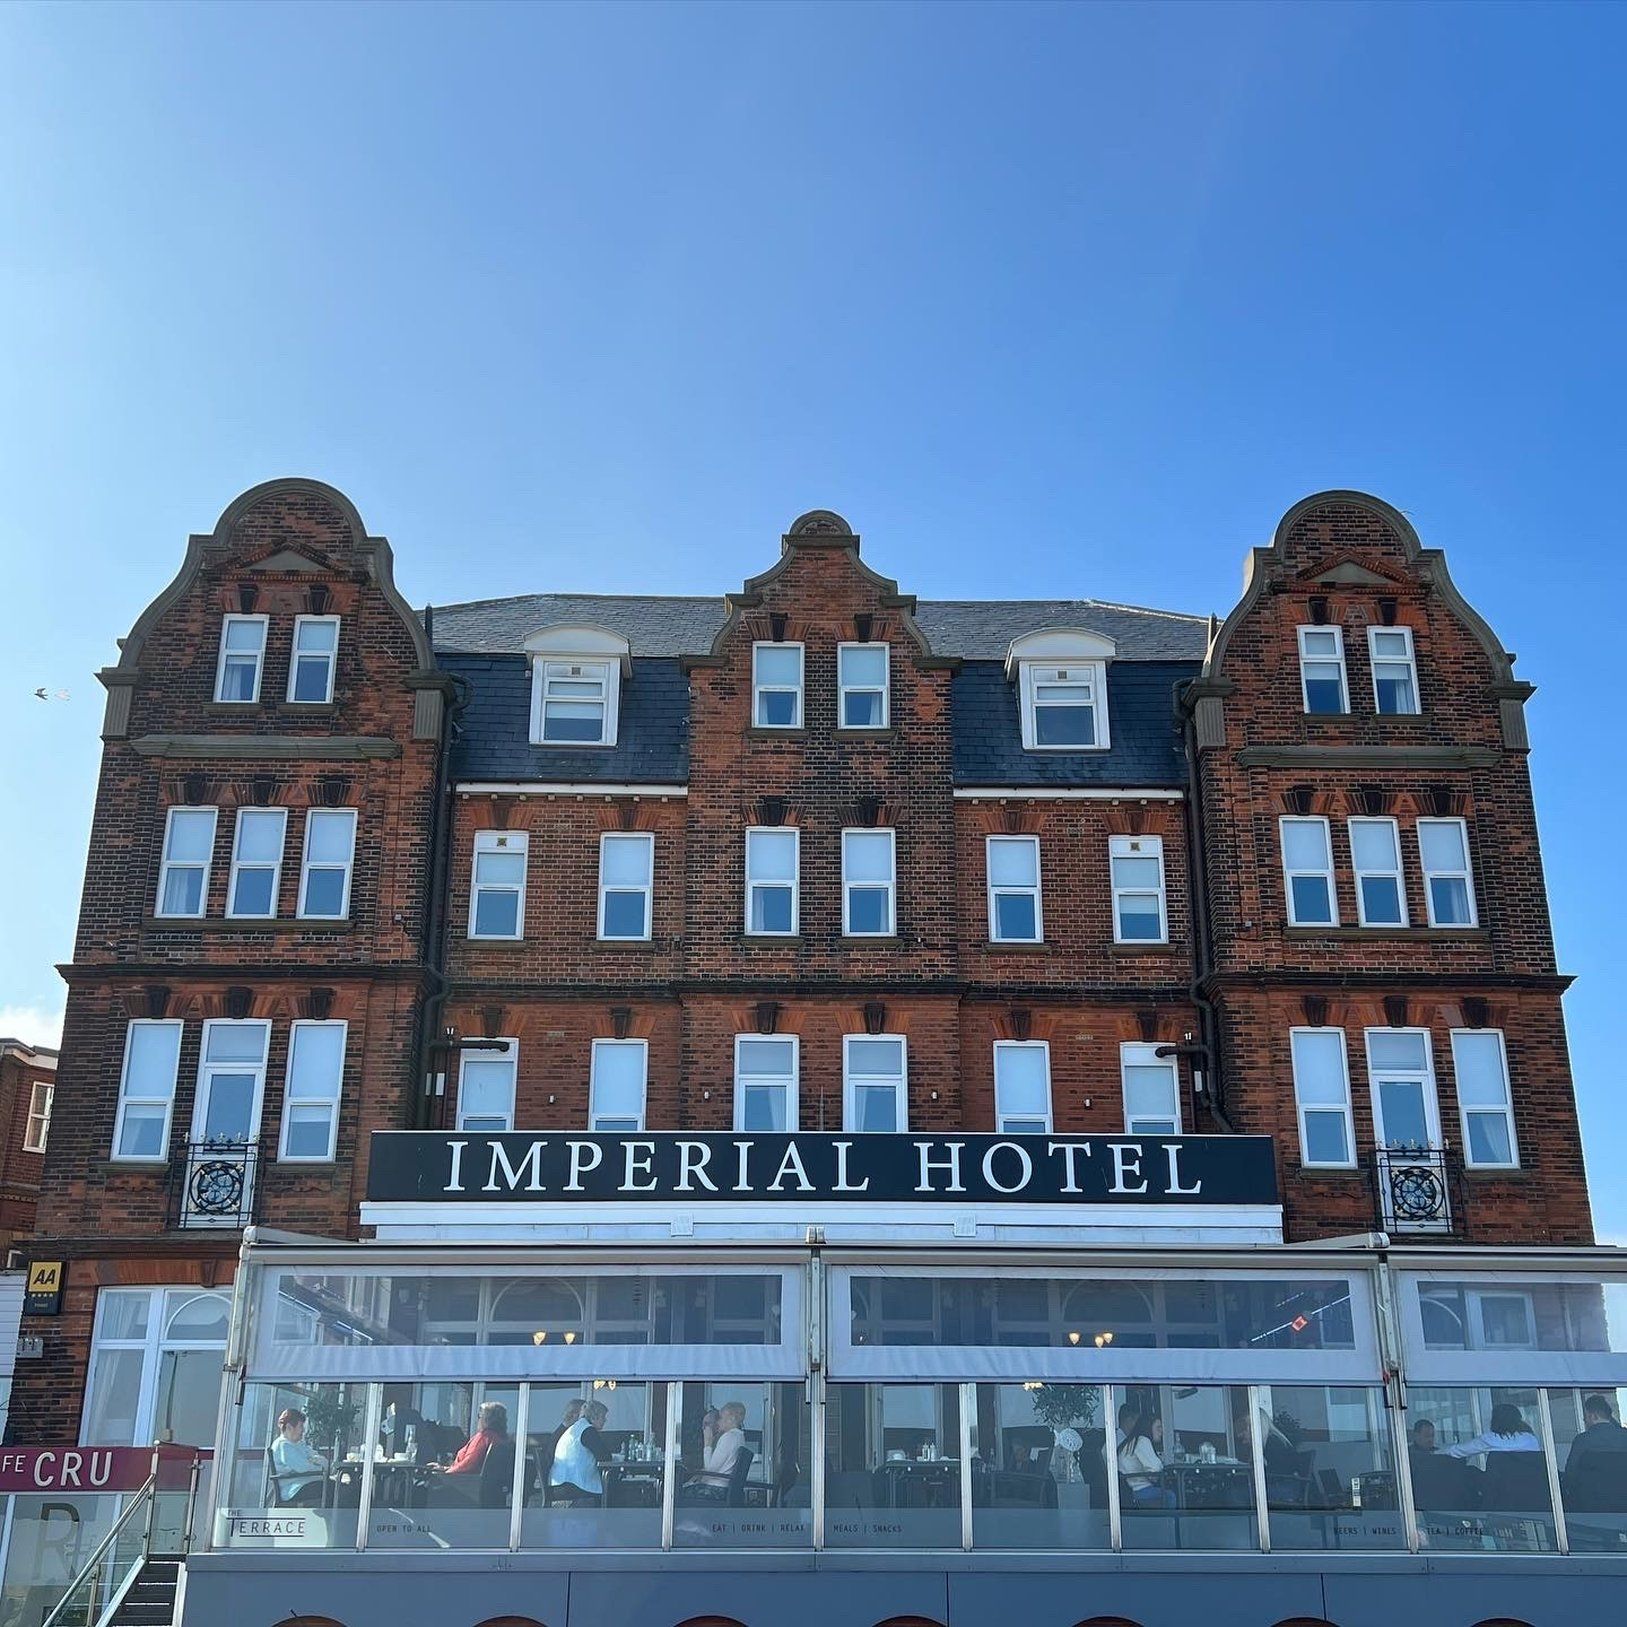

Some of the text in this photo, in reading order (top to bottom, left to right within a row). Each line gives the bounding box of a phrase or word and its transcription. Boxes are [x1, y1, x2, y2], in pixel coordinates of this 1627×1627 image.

[443, 1141, 1202, 1194] IMPERIAL HOTEL
[33, 1269, 56, 1285] AA
[33, 1451, 112, 1487] CRU
[226, 1517, 305, 1537] TERRACE
[417, 1525, 431, 1533] ALL
[712, 1524, 804, 1532] EAT DRINK RELAX
[833, 1524, 902, 1532] MEALS SNACKS
